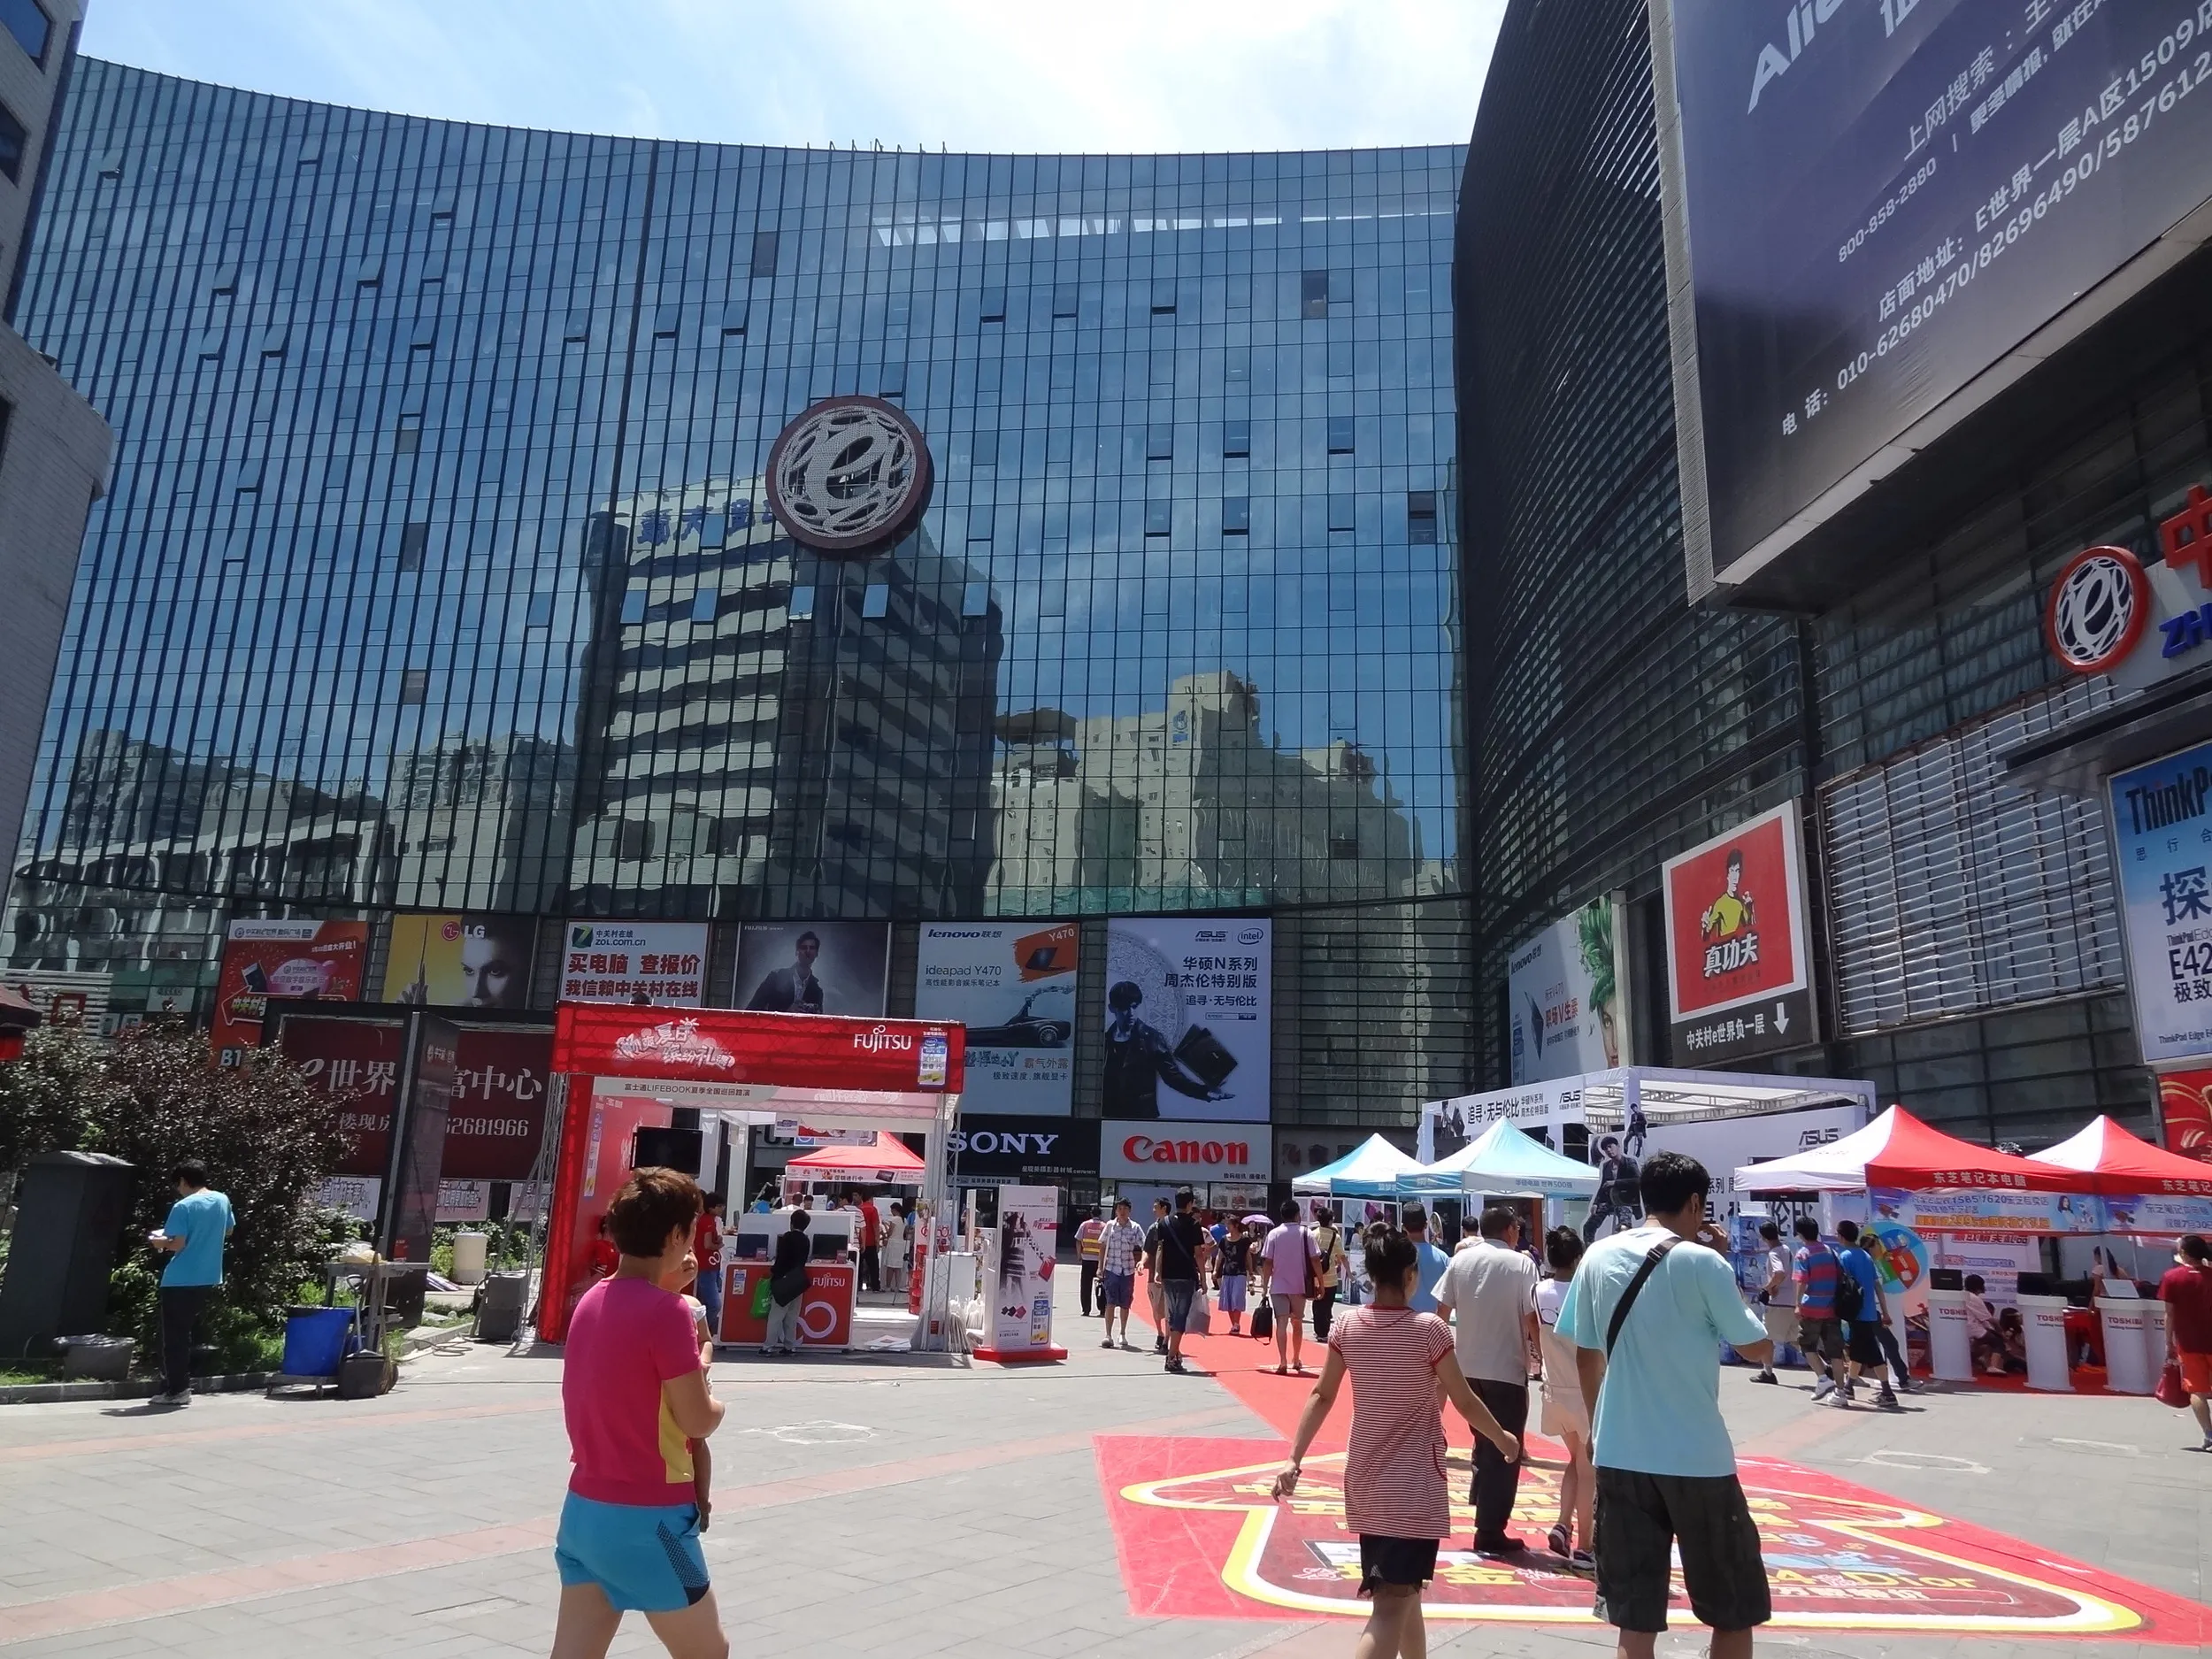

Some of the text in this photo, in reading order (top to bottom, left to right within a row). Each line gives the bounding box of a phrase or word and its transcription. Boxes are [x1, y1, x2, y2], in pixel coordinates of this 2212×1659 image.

[1839, 0, 2108, 263] 800-858-2880 更多情报，就在
[2125, 765, 2212, 834] ThinkP
[465, 925, 485, 939] LG
[927, 928, 979, 938] lenovo
[1048, 927, 1074, 942] Y470
[1195, 930, 1261, 941] ASUS intel
[567, 953, 702, 975] 买电脑 查报价
[1183, 956, 1258, 972] 华硕N系列
[1510, 951, 1532, 976] lenovo
[1703, 932, 1759, 979] 真功夫
[926, 964, 1002, 979] ideapad Y470
[565, 979, 699, 999] 我信赖中关村在线
[926, 979, 1001, 987] 高性能影音娱乐笔记本
[1164, 972, 1257, 989] 周杰伦特别版
[1686, 1013, 1765, 1051] 中关村e世界负一层
[2158, 1033, 2187, 1044] ThinkPad
[853, 1033, 912, 1054] FUJITSU
[221, 1049, 242, 1067] B1
[1558, 1089, 1582, 1104] ASUS
[946, 1130, 1059, 1155] SONY
[1798, 1127, 1840, 1147] ASUS
[1122, 1135, 1248, 1165] Canon
[1932, 1171, 2027, 1187] 东芝笔记本电脑
[2161, 1179, 2212, 1194] 东芝笔记
[812, 1276, 846, 1288] FUJITSU
